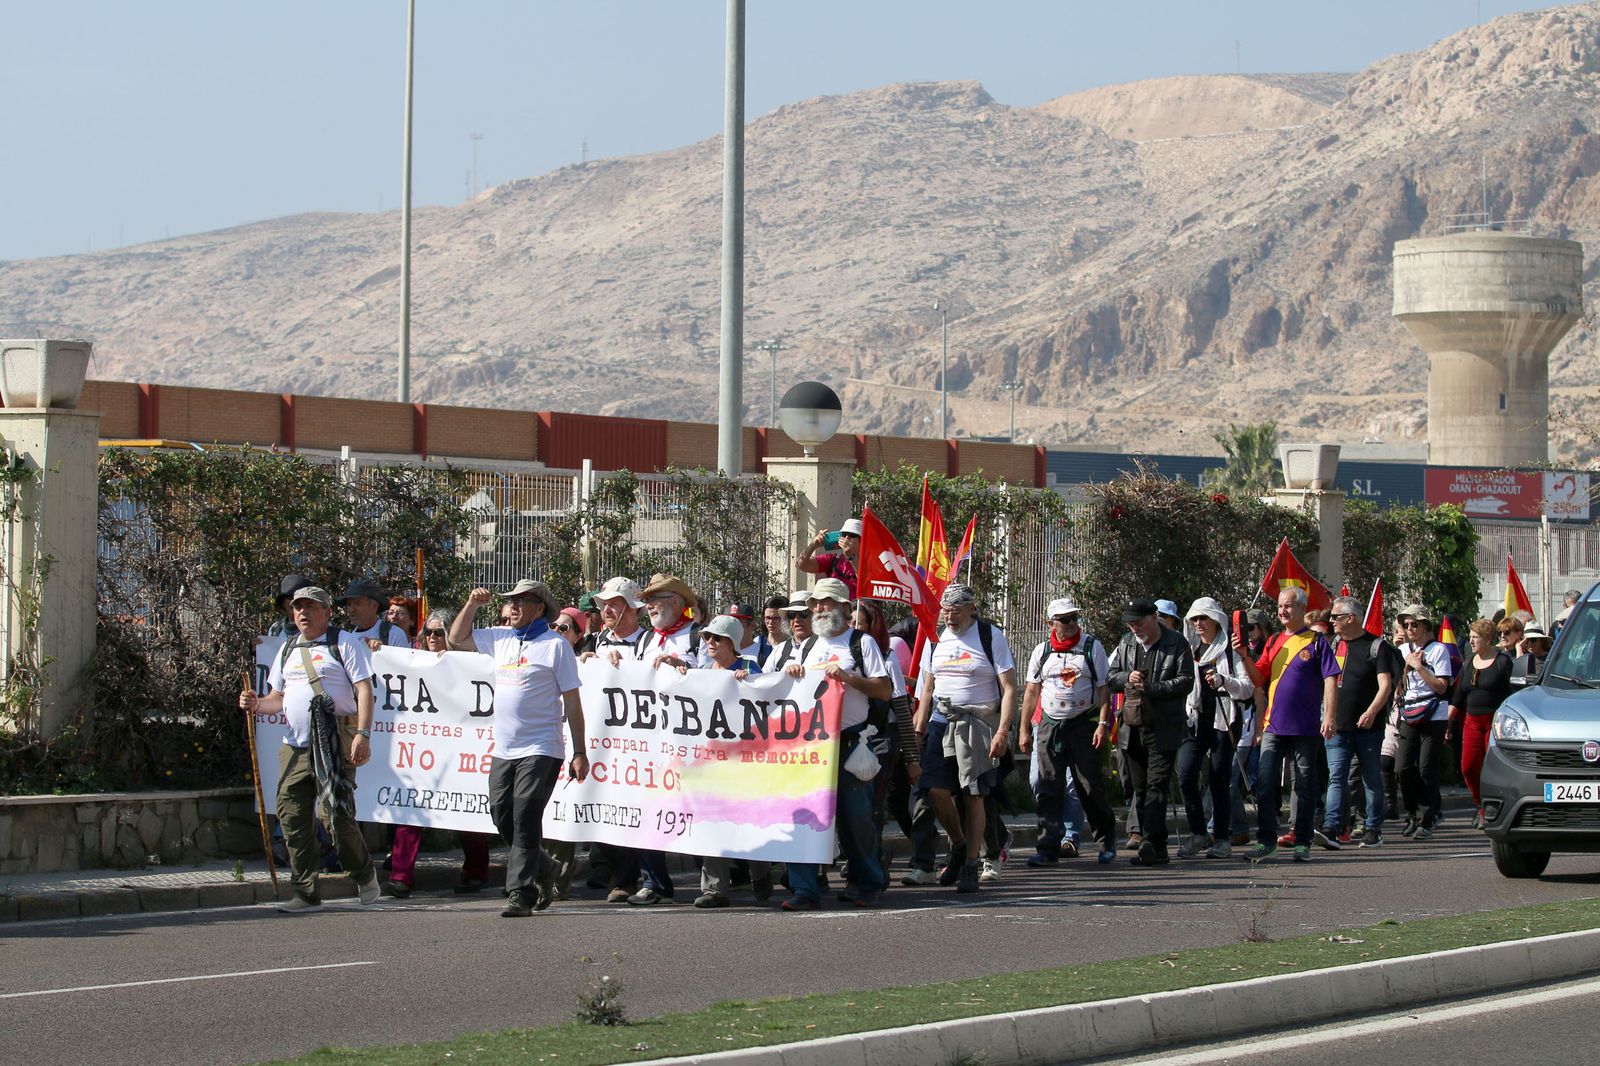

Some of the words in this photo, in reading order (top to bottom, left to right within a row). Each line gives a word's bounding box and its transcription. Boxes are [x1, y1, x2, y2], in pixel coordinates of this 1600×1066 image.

[1352, 478, 1382, 496] S.L.
[1449, 483, 1472, 493] ORAN
[1476, 484, 1522, 495] GHAZAOUET
[373, 720, 463, 738] nuestras
[590, 737, 649, 753] rompan
[741, 748, 828, 766] memoria.
[1585, 747, 1597, 757] FIAT
[395, 741, 435, 770] No
[457, 742, 495, 774] má
[1556, 785, 1592, 800] 2446
[377, 786, 491, 815] CARRETER
[573, 803, 642, 828] MUERTE
[656, 809, 693, 837] 1937
